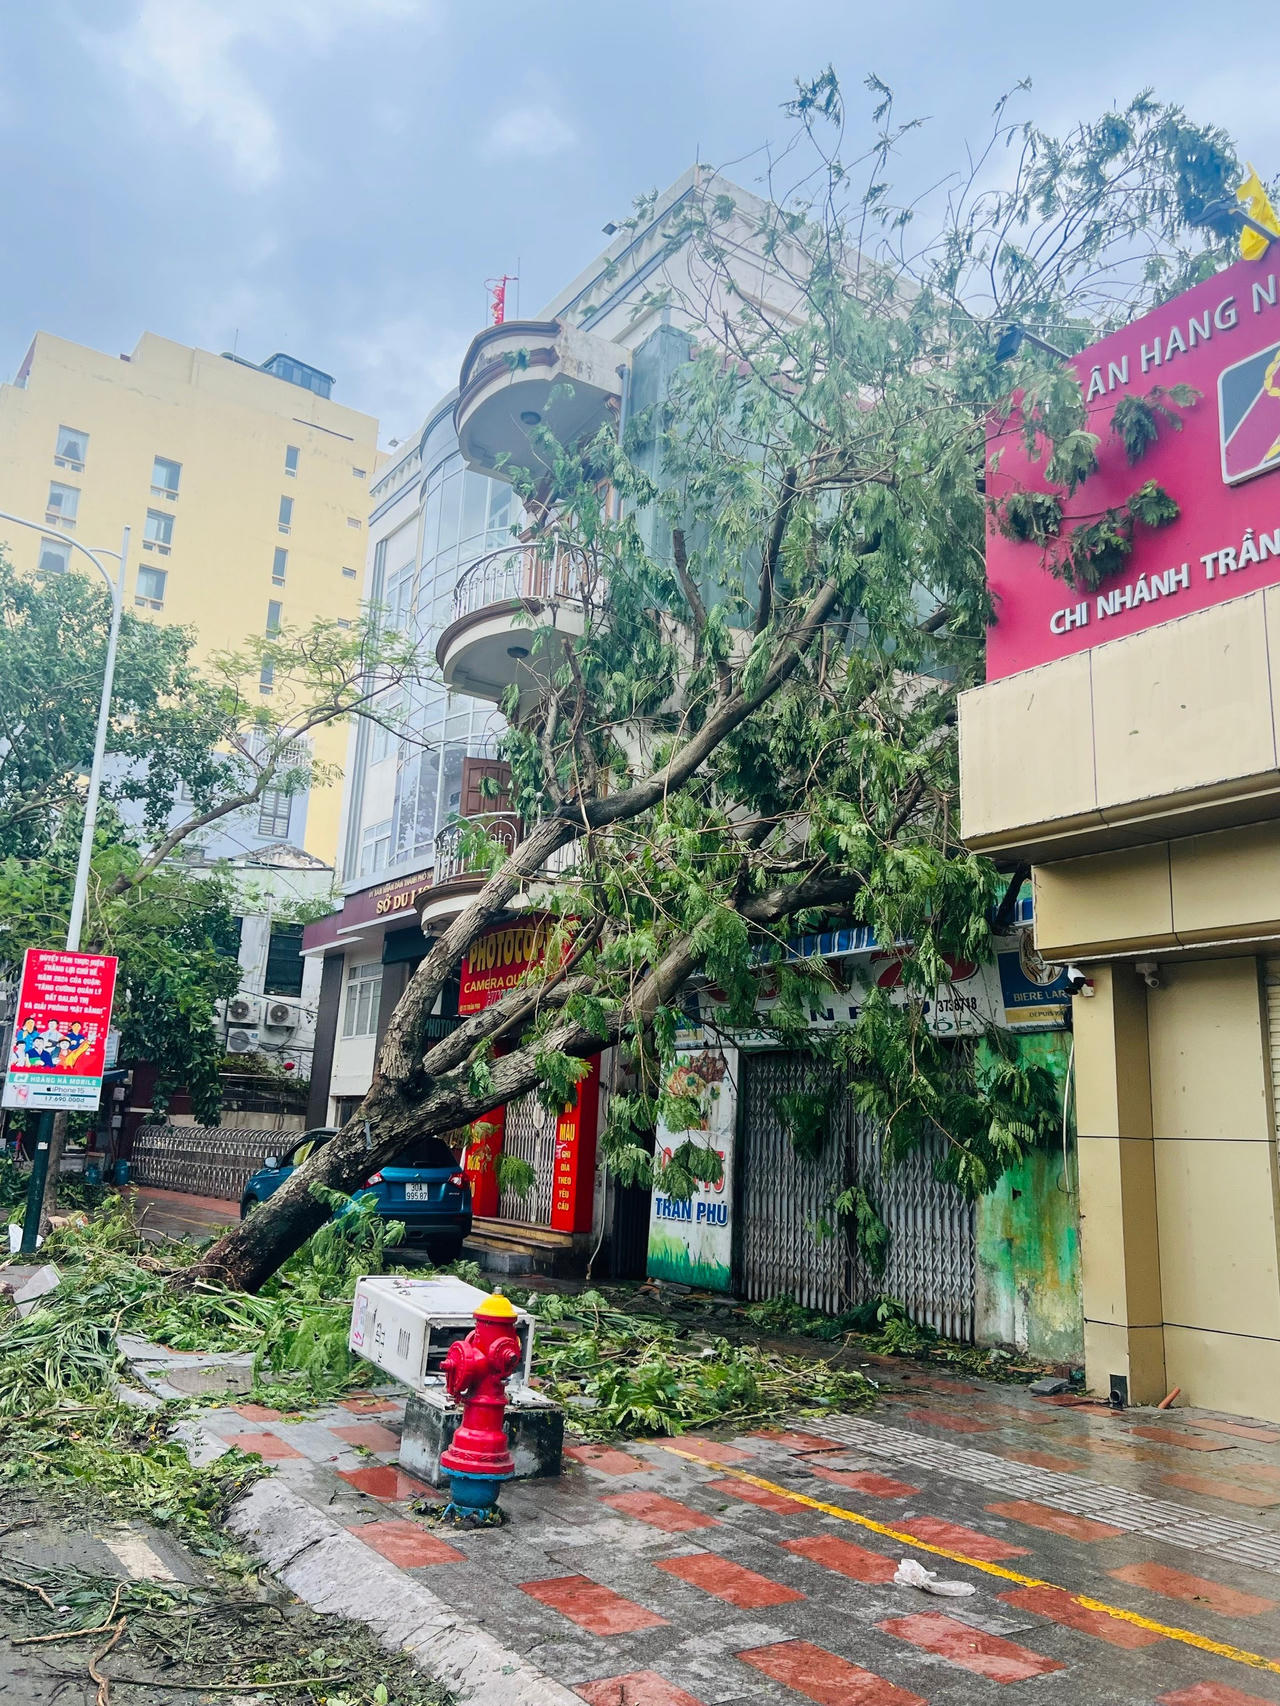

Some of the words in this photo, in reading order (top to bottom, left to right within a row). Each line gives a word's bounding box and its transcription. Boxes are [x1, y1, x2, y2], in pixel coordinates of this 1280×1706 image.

[1080, 354, 1129, 403] ÂN
[1050, 601, 1090, 634] CHI
[1096, 562, 1191, 619] NHÁNH
[376, 893, 392, 914] SỞ
[393, 891, 409, 910] DU
[464, 976, 504, 993] CAMERA
[1013, 991, 1044, 1002] BIERE
[411, 1183, 422, 1191] 30A
[558, 1177, 572, 1185] THEO
[697, 1200, 728, 1224] PHÚ
